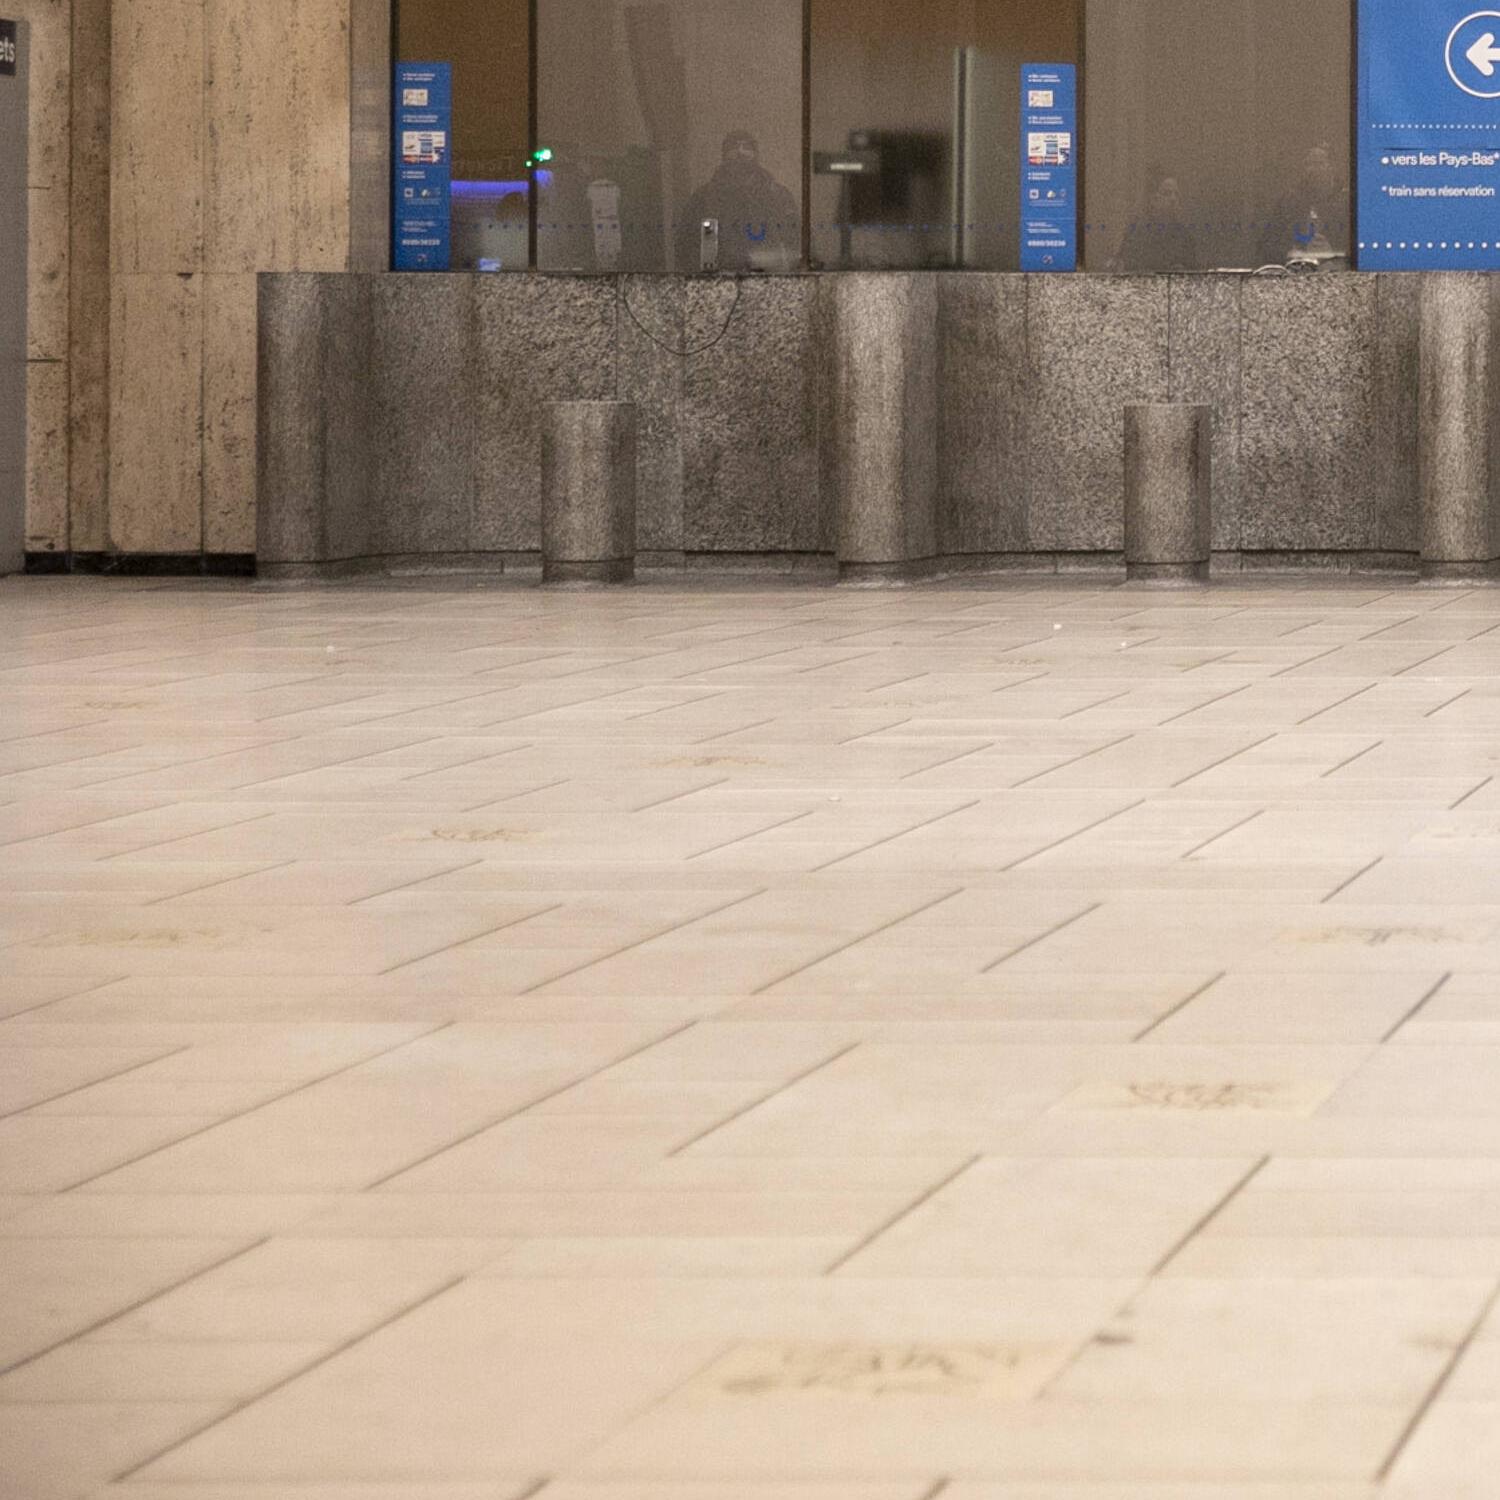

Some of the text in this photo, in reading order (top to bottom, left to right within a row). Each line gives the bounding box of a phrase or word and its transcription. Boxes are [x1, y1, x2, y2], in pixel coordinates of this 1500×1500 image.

[1391, 155, 1417, 166] vers
[1419, 152, 1437, 166] les
[1388, 185, 1495, 197] train sans réservation
